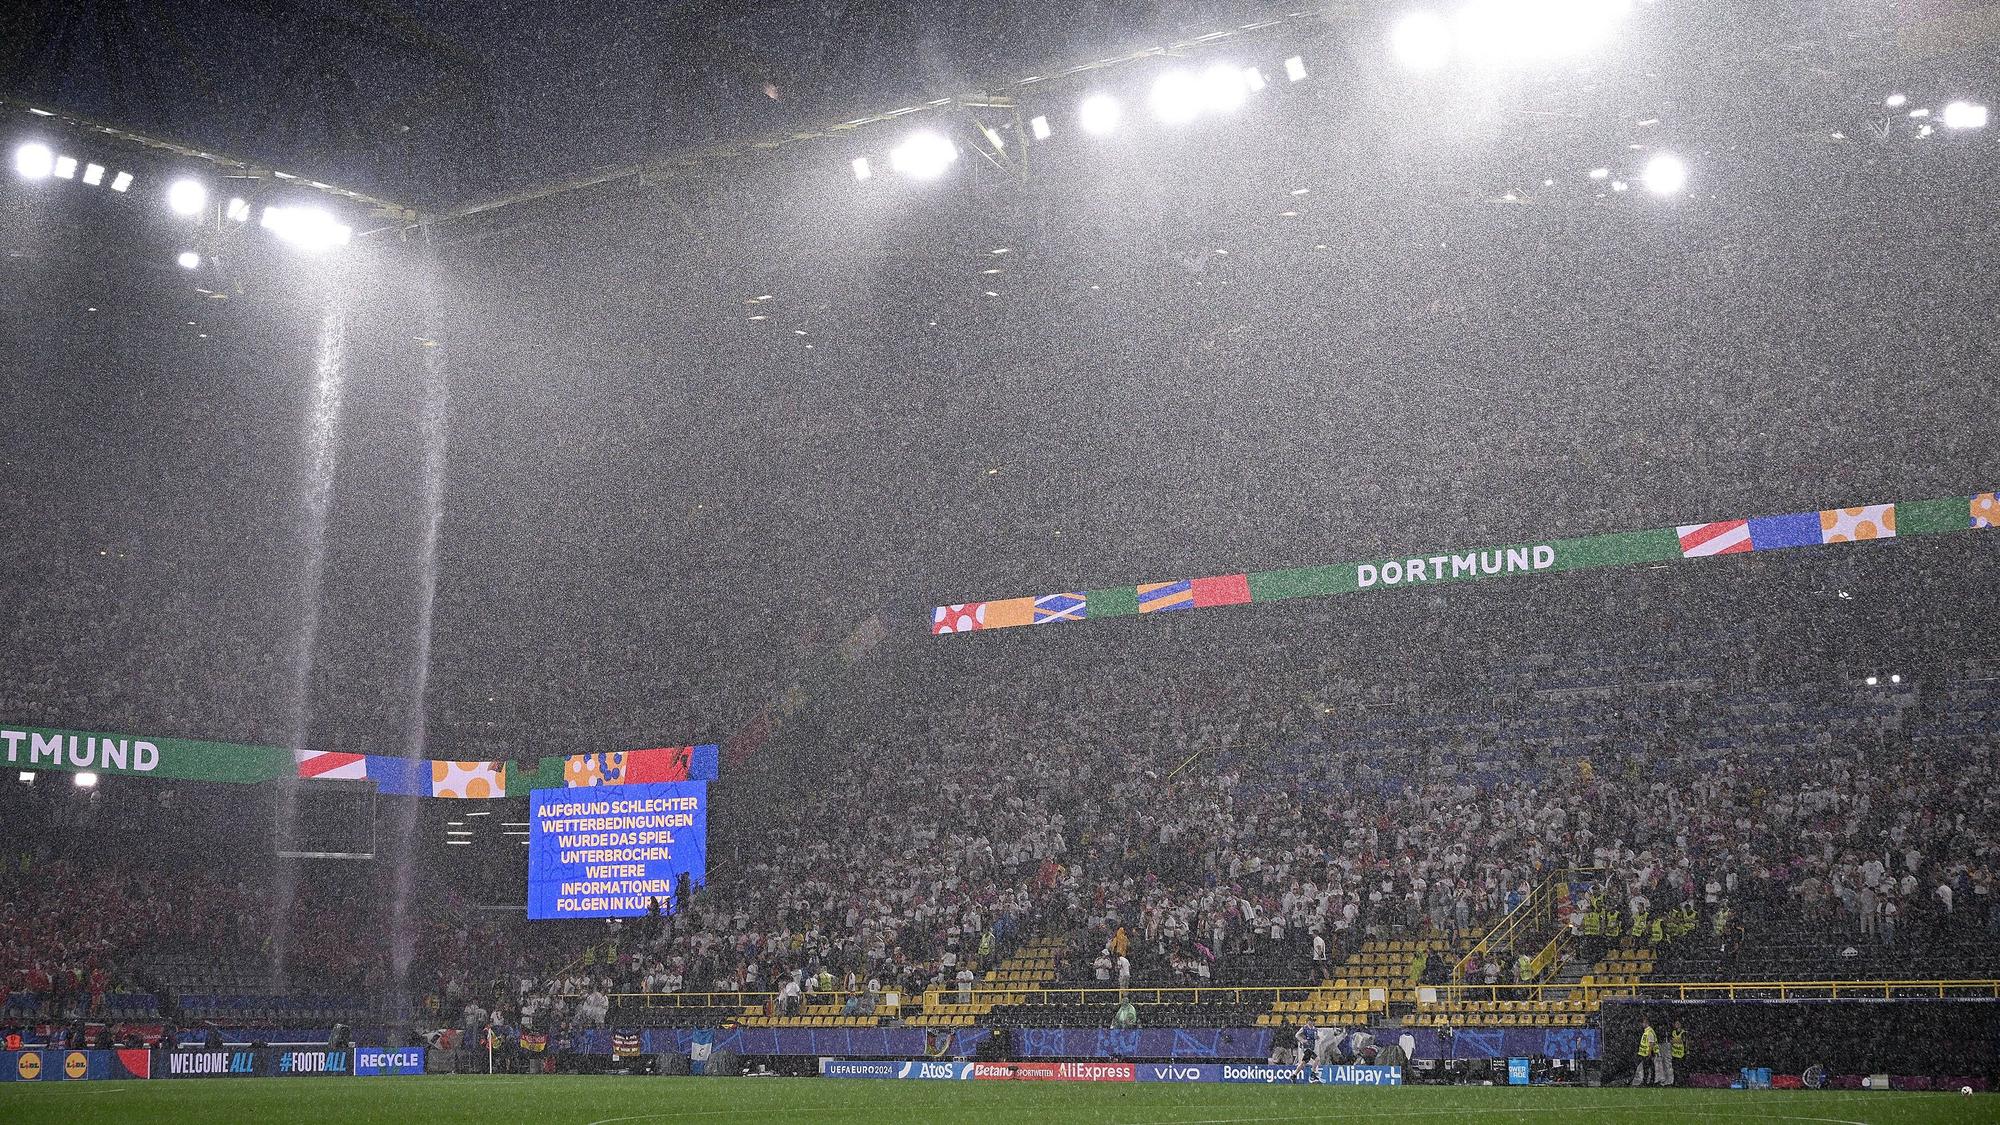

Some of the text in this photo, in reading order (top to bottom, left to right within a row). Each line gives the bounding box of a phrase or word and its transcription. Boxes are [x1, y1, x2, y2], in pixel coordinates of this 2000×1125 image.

[1357, 545, 1555, 587] DORTMUND
[538, 797, 698, 818] AUFGRUND SCHLECHTER
[542, 814, 693, 832] WETTERBEDINGUNGEN
[559, 831, 674, 848] WURDE DAS SPIEL
[560, 847, 672, 863] UNTERBROCHEN.
[586, 864, 645, 879] WEITERE
[561, 880, 670, 895] INFORMATIONEN
[557, 897, 608, 911] FOLGEN
[611, 897, 622, 910] IN
[170, 1052, 256, 1073] WELCOME ALL
[280, 1051, 347, 1072] #FOOTBALL
[361, 1053, 418, 1067] RECYCLE
[1058, 1062, 1131, 1081] AliExpress
[1223, 1065, 1304, 1082] Booking.com
